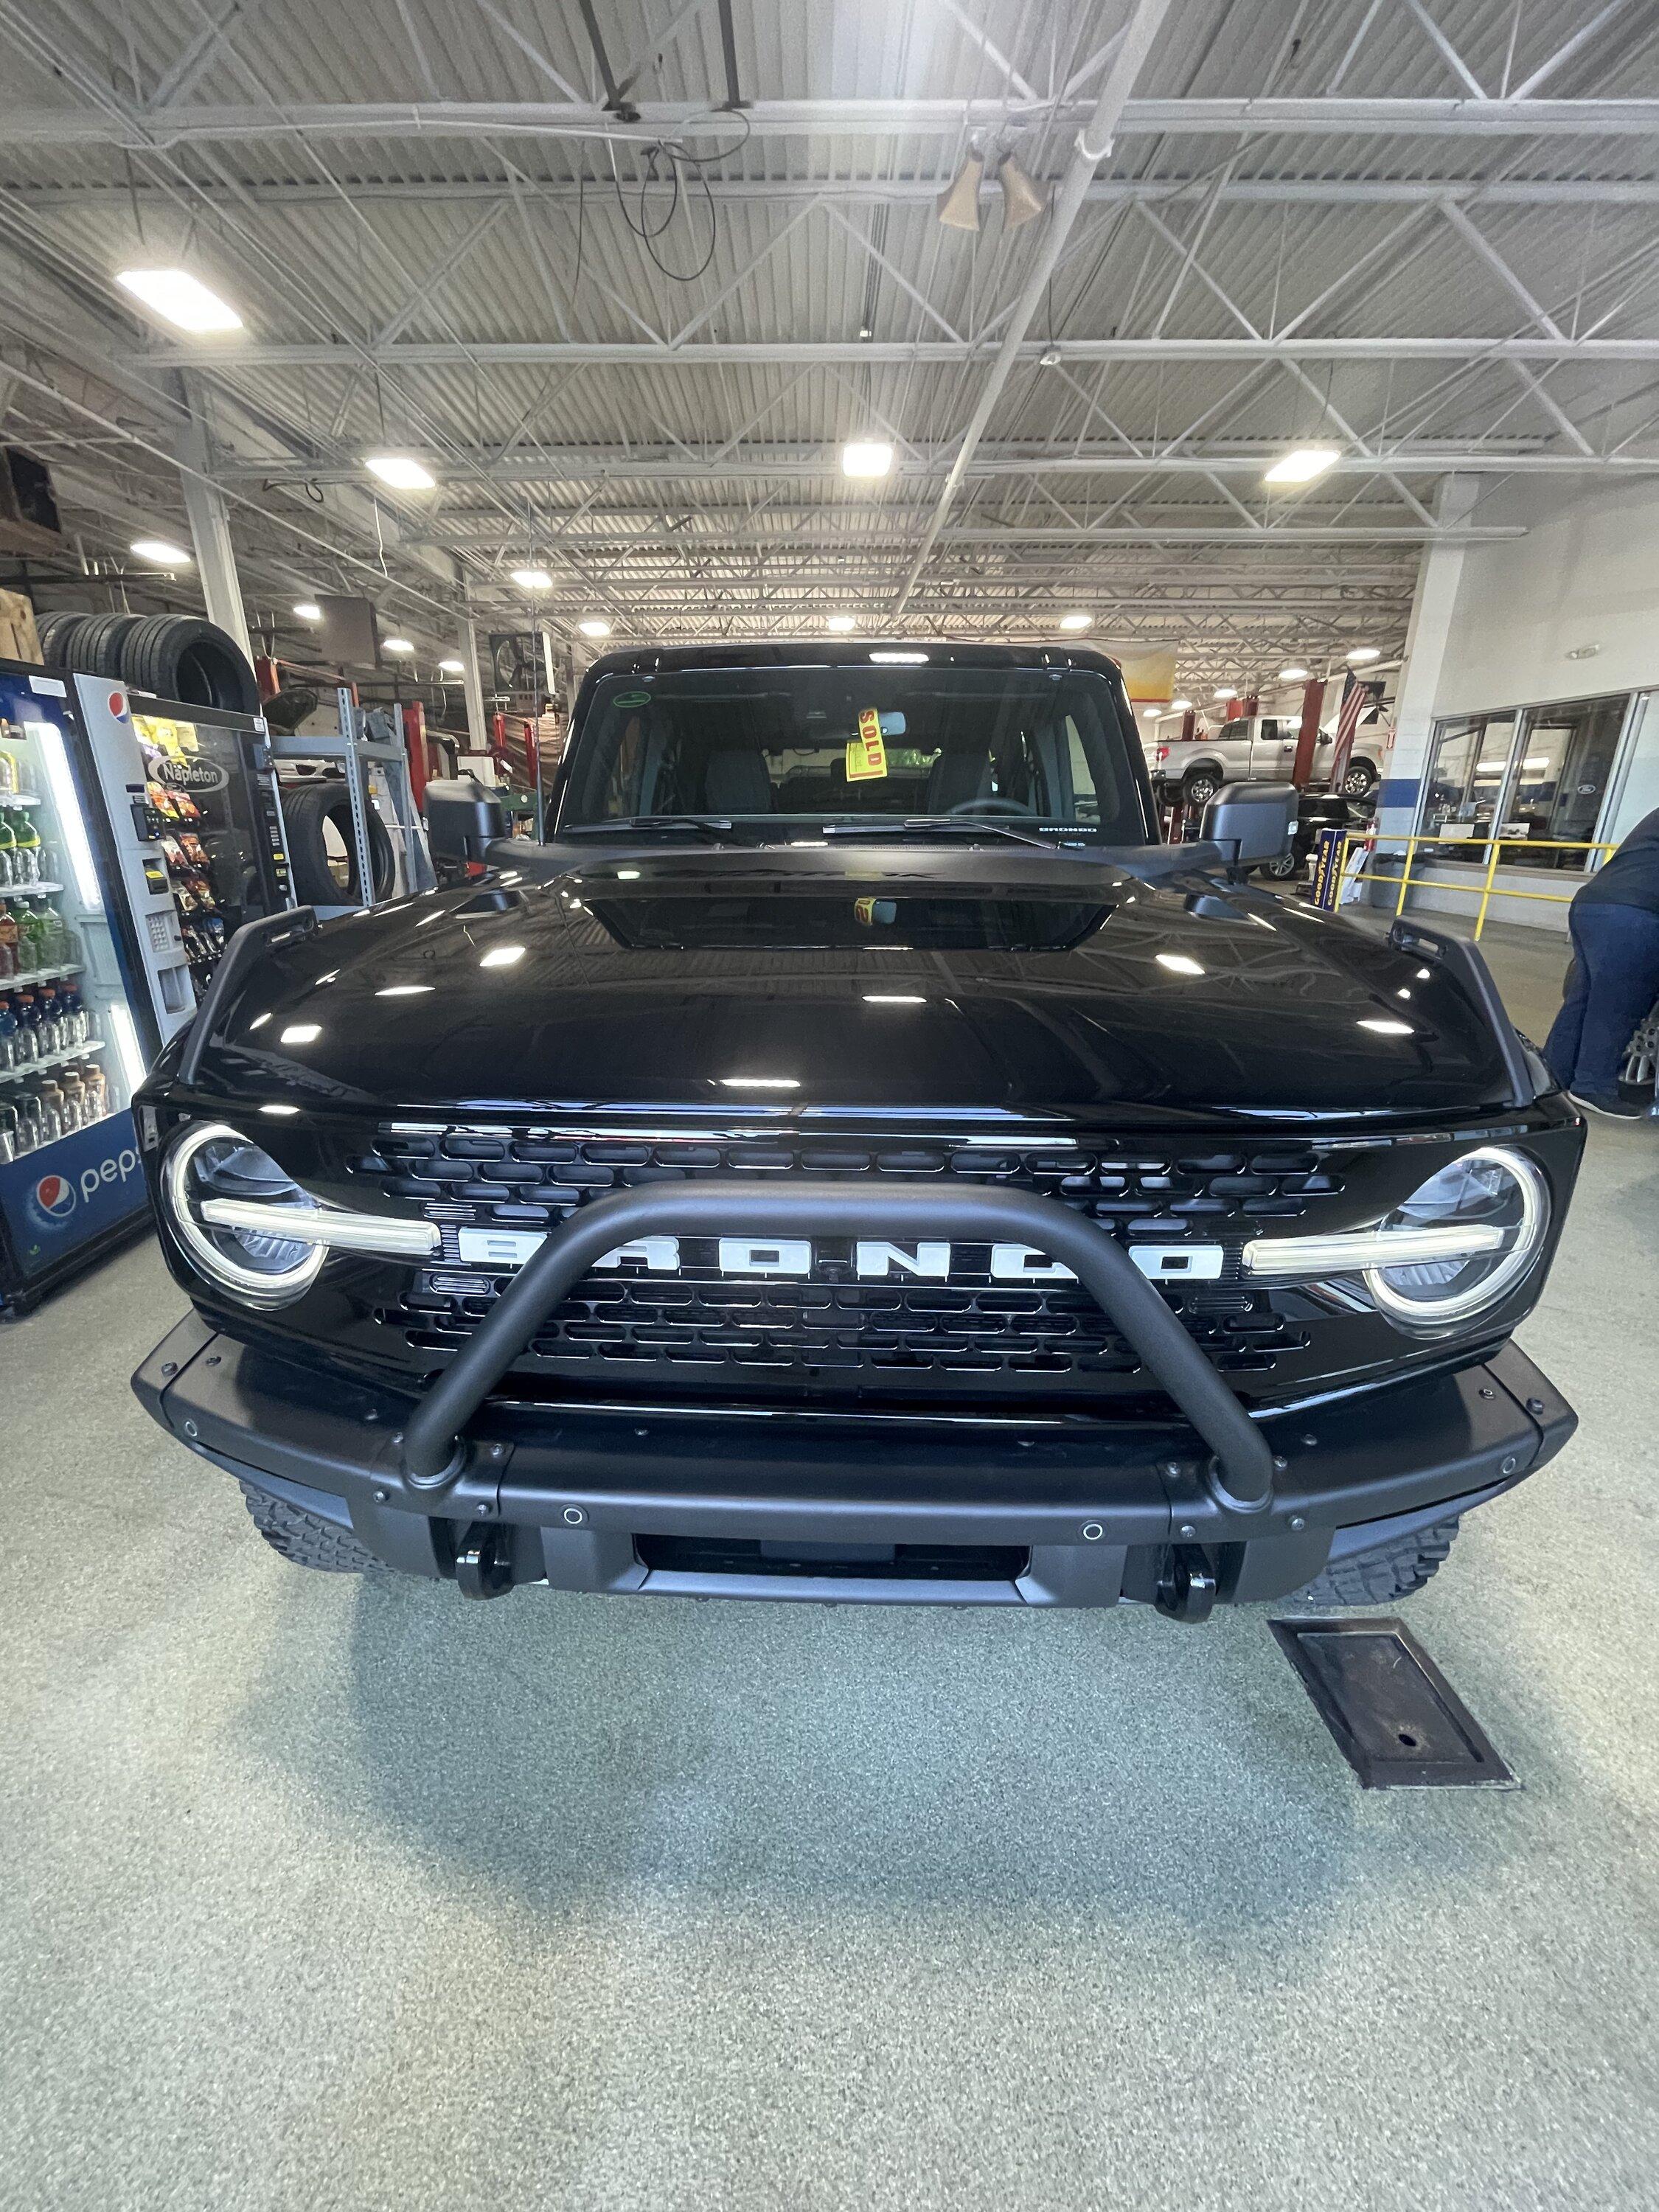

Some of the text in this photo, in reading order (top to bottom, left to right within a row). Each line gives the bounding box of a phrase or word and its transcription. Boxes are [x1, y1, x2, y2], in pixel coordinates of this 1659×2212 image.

[860, 710, 883, 766] SOLD
[163, 762, 219, 786] Napleton
[1314, 841, 1330, 905] GOODYEAR
[1327, 841, 1342, 906] GOODYEAR
[80, 1150, 142, 1203] pep
